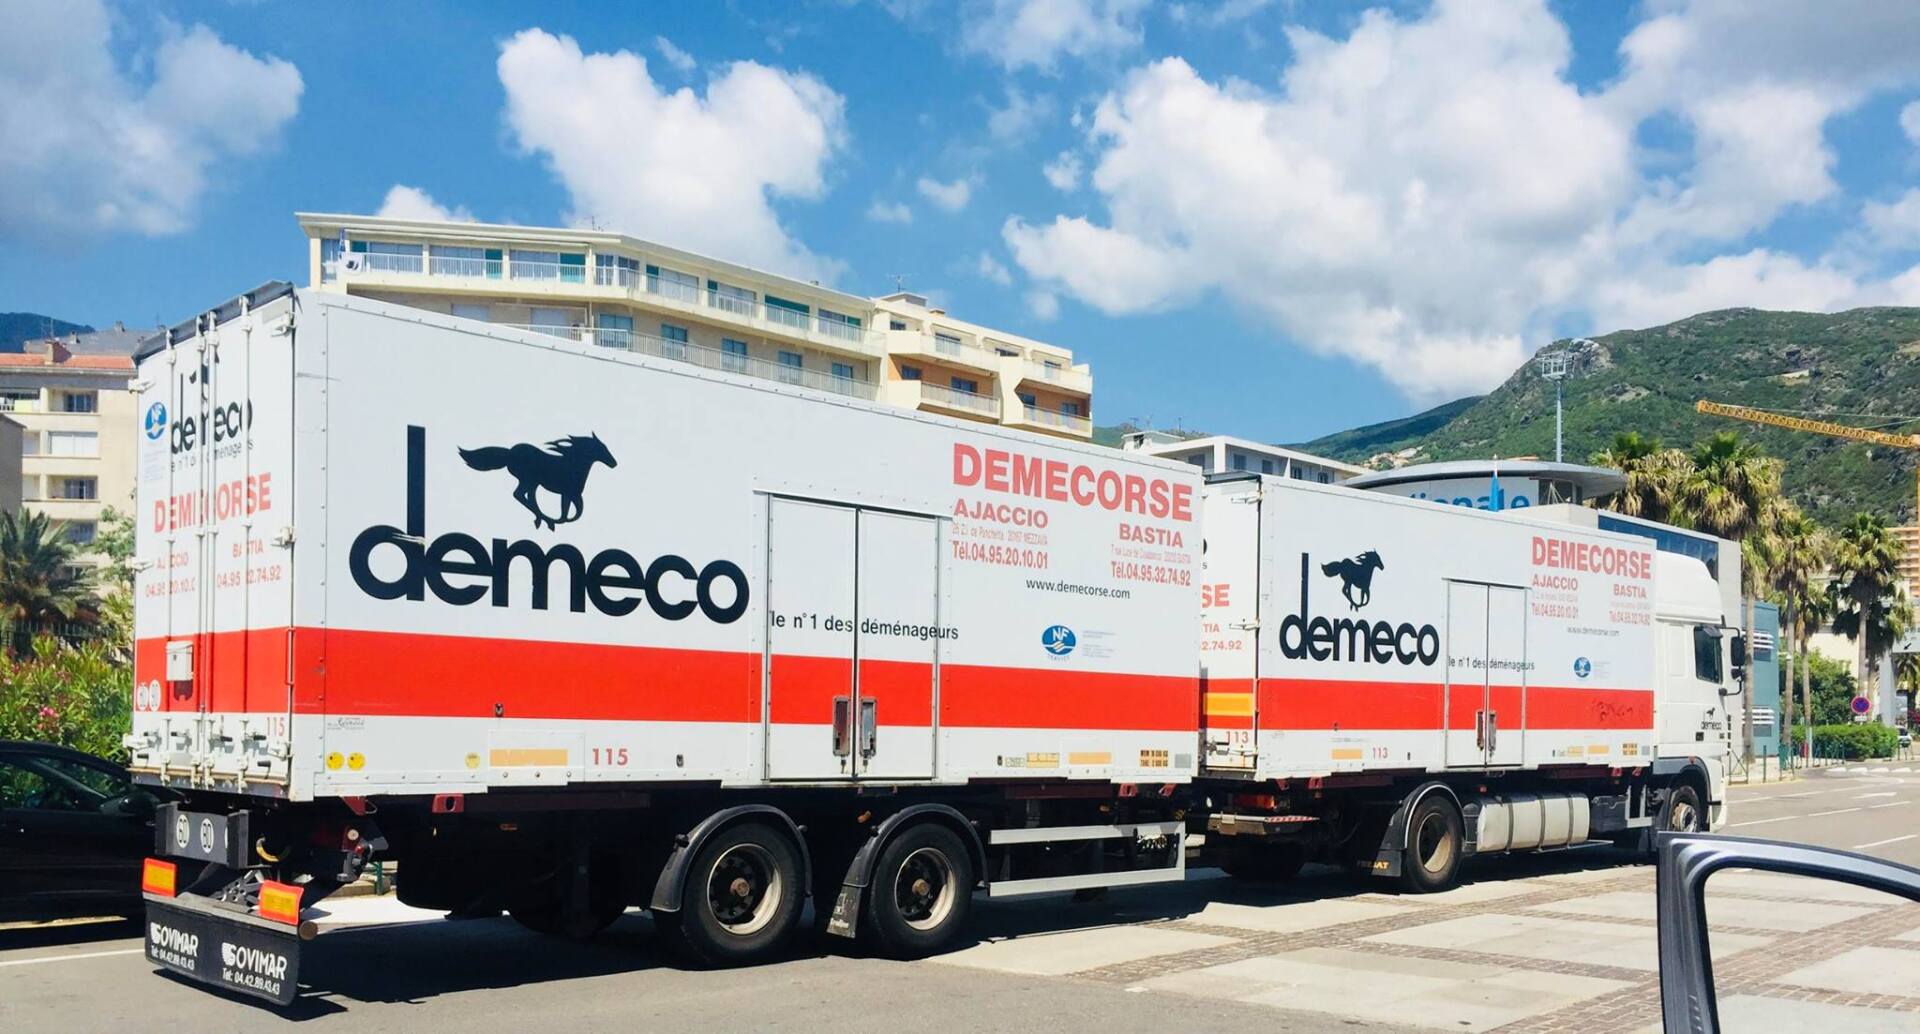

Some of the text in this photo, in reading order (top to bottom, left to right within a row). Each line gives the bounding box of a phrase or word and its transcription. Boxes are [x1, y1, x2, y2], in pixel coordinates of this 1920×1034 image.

[953, 442, 1193, 522] DEMECORSE
[349, 424, 749, 624] demeco
[953, 498, 1048, 529] AJACCIO
[1119, 523, 1183, 548] BASTIA
[1532, 536, 1651, 580] DEMECORSE
[1026, 578, 1130, 600] www.demecorse.com
[1532, 574, 1578, 591] AJACCIO
[1613, 584, 1647, 599] BASTIA
[1279, 552, 1440, 666] demeco
[771, 610, 785, 627] le
[824, 615, 853, 632] des
[861, 618, 959, 641] déménageurs
[1052, 627, 1070, 641] NF
[267, 717, 285, 736] 115
[1226, 731, 1248, 743] 113
[592, 747, 628, 766] 115
[1373, 747, 1387, 759] 113
[151, 922, 198, 957] SOVIMAR
[222, 942, 287, 981] SOVIMAR
